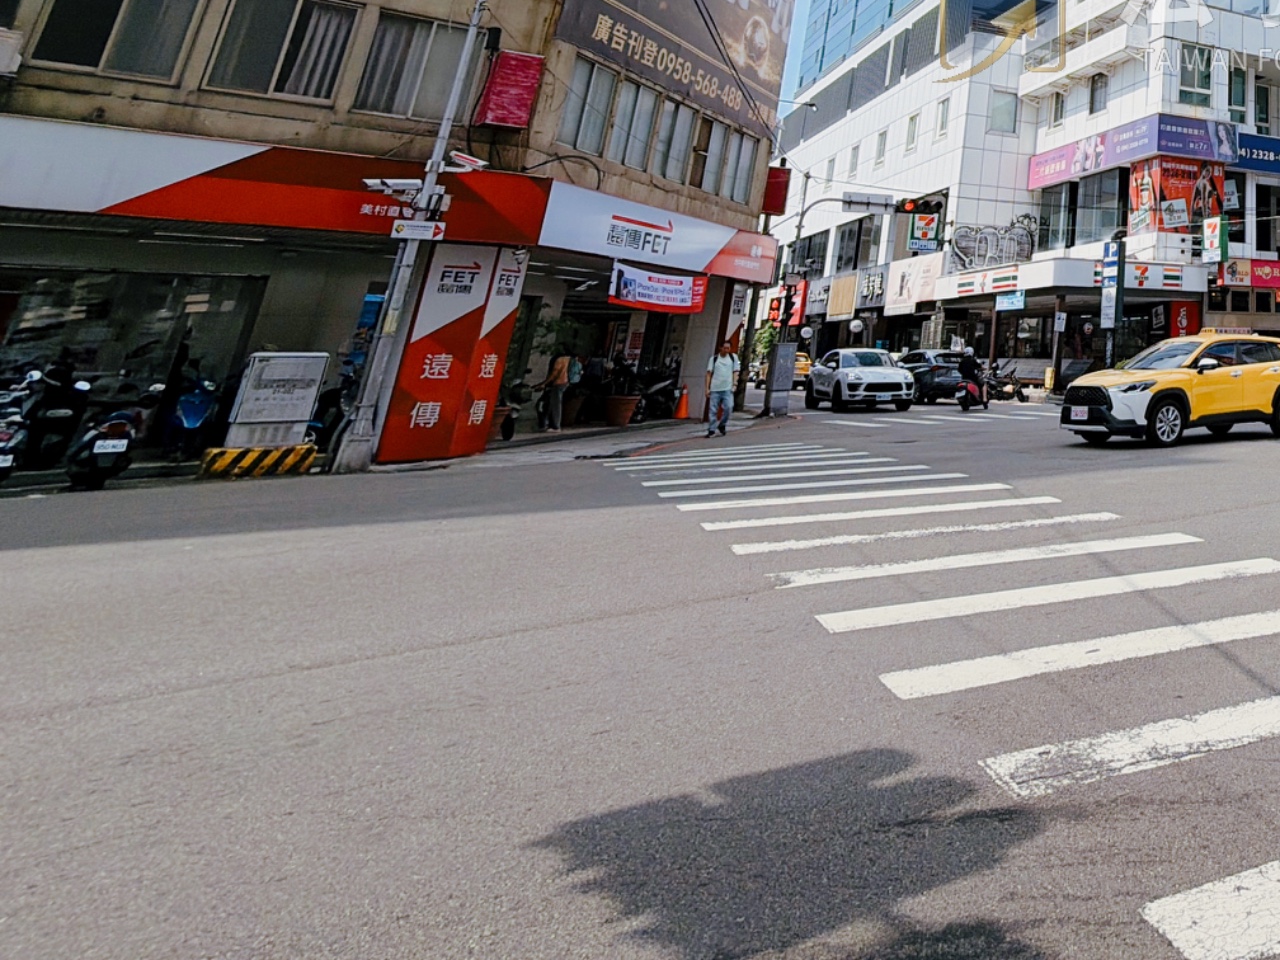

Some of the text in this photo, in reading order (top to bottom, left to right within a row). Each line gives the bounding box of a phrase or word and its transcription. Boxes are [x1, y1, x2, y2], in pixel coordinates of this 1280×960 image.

[1109, 244, 1118, 258] P
[440, 270, 481, 284] FET
[498, 273, 520, 287] FET
[409, 353, 454, 429] 遠傳
[467, 353, 499, 426] 遠傳
